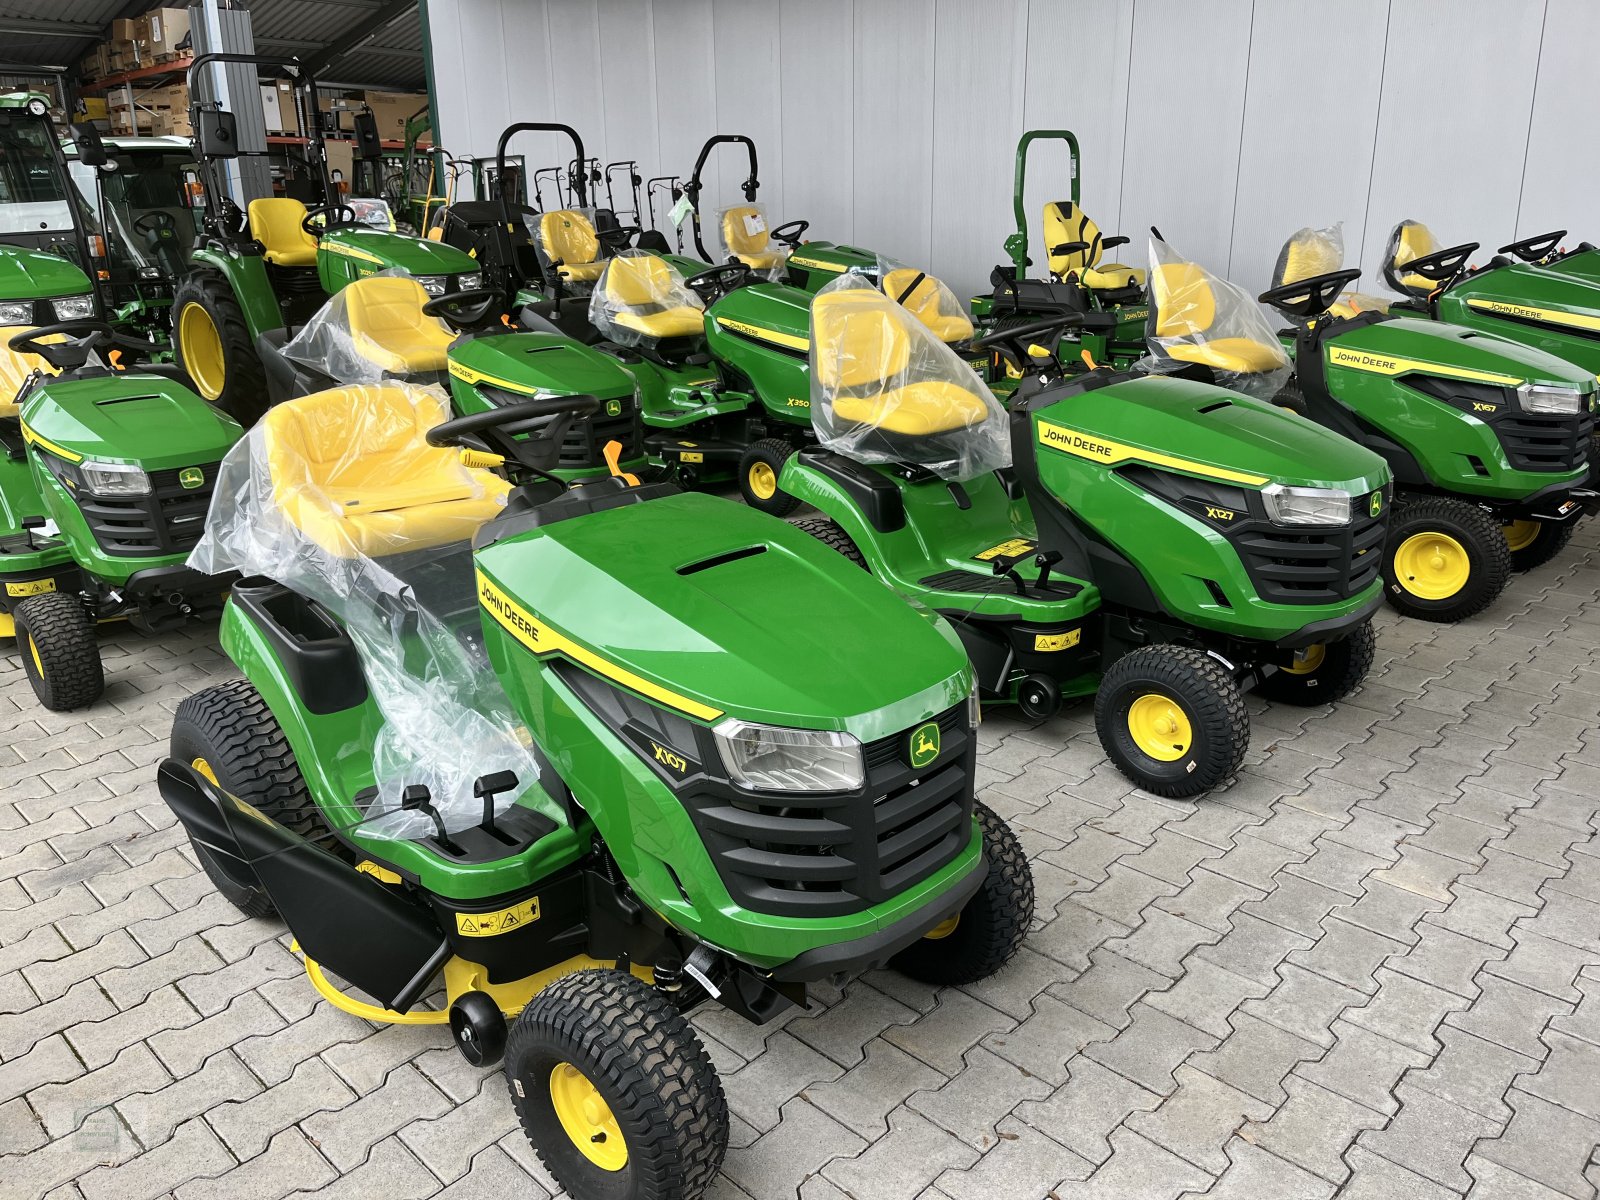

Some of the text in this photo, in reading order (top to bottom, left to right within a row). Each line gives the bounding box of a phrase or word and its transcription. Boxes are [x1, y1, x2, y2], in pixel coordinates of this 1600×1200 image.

[1489, 303, 1543, 319] JOHN DEERE
[729, 321, 759, 336] JOHN DEERE
[1335, 351, 1397, 370] JOHN DEERE
[460, 367, 473, 380] DEERE
[1472, 402, 1497, 412] X167
[1044, 428, 1112, 457] JOHN DEERE
[1205, 506, 1234, 520] X127
[481, 582, 539, 643] JOHN DEERE
[651, 742, 687, 773] X107
